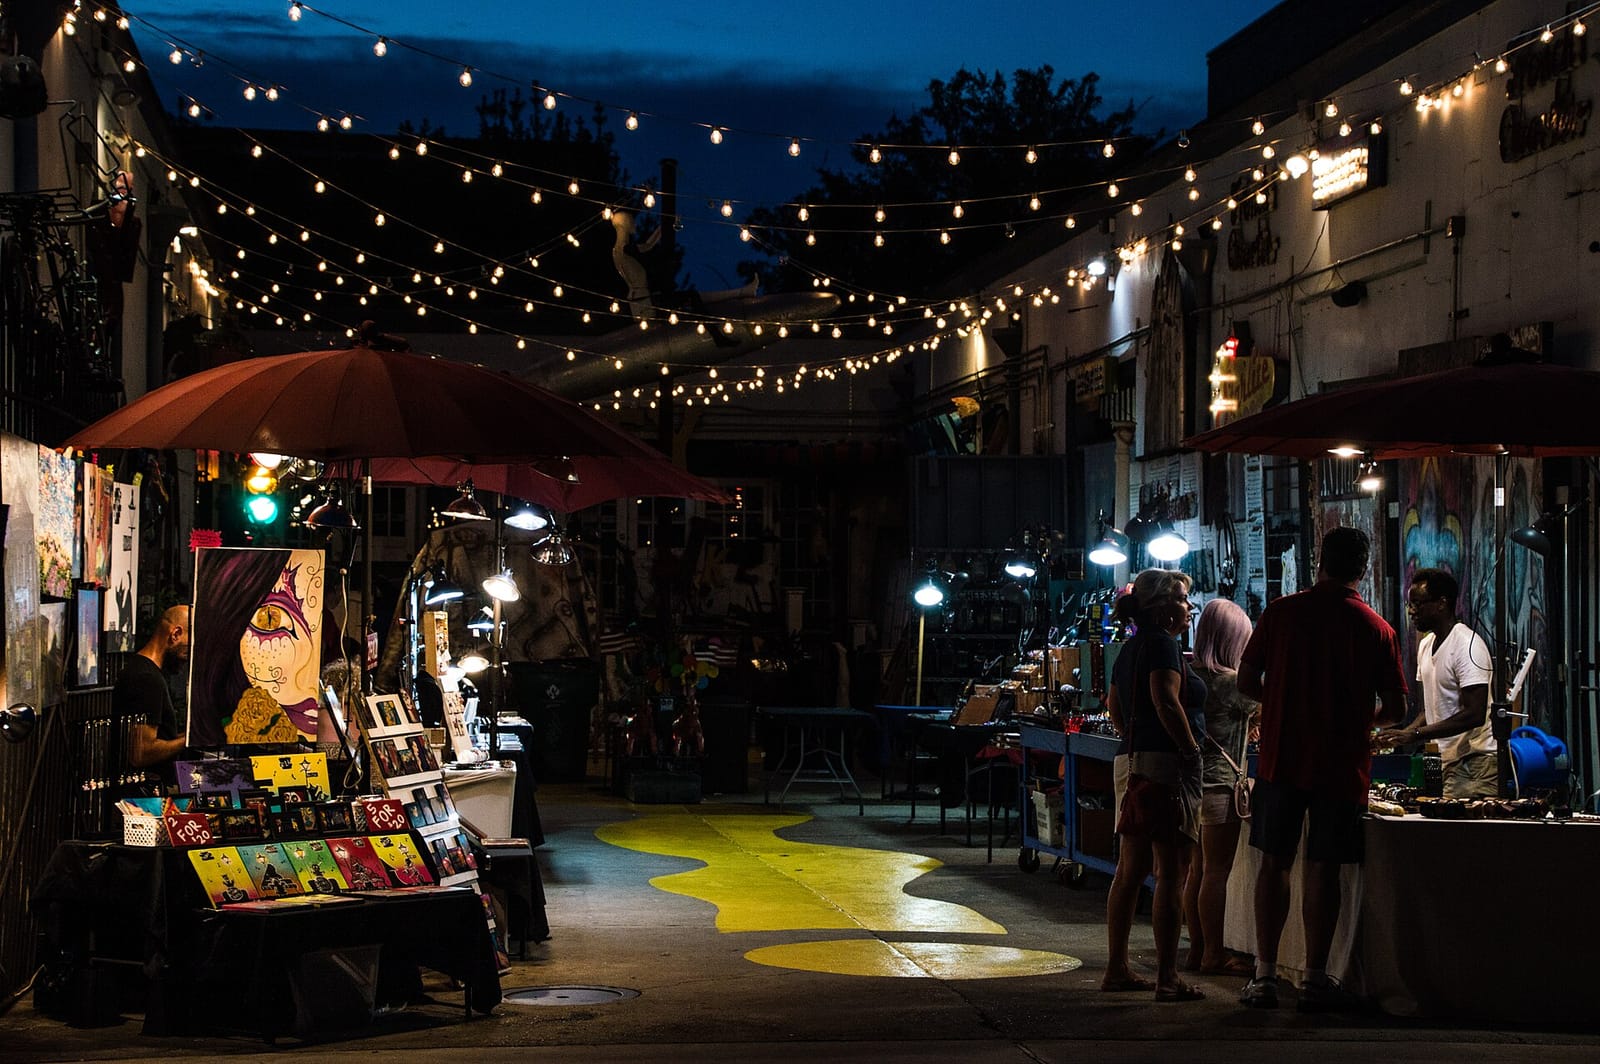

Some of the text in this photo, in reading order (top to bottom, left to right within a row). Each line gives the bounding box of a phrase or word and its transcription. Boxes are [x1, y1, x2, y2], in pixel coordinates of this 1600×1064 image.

[366, 803, 377, 815] 5
[372, 804, 396, 829] FOR
[168, 817, 179, 828] 2
[387, 814, 405, 830] $20
[176, 820, 202, 842] FOR
